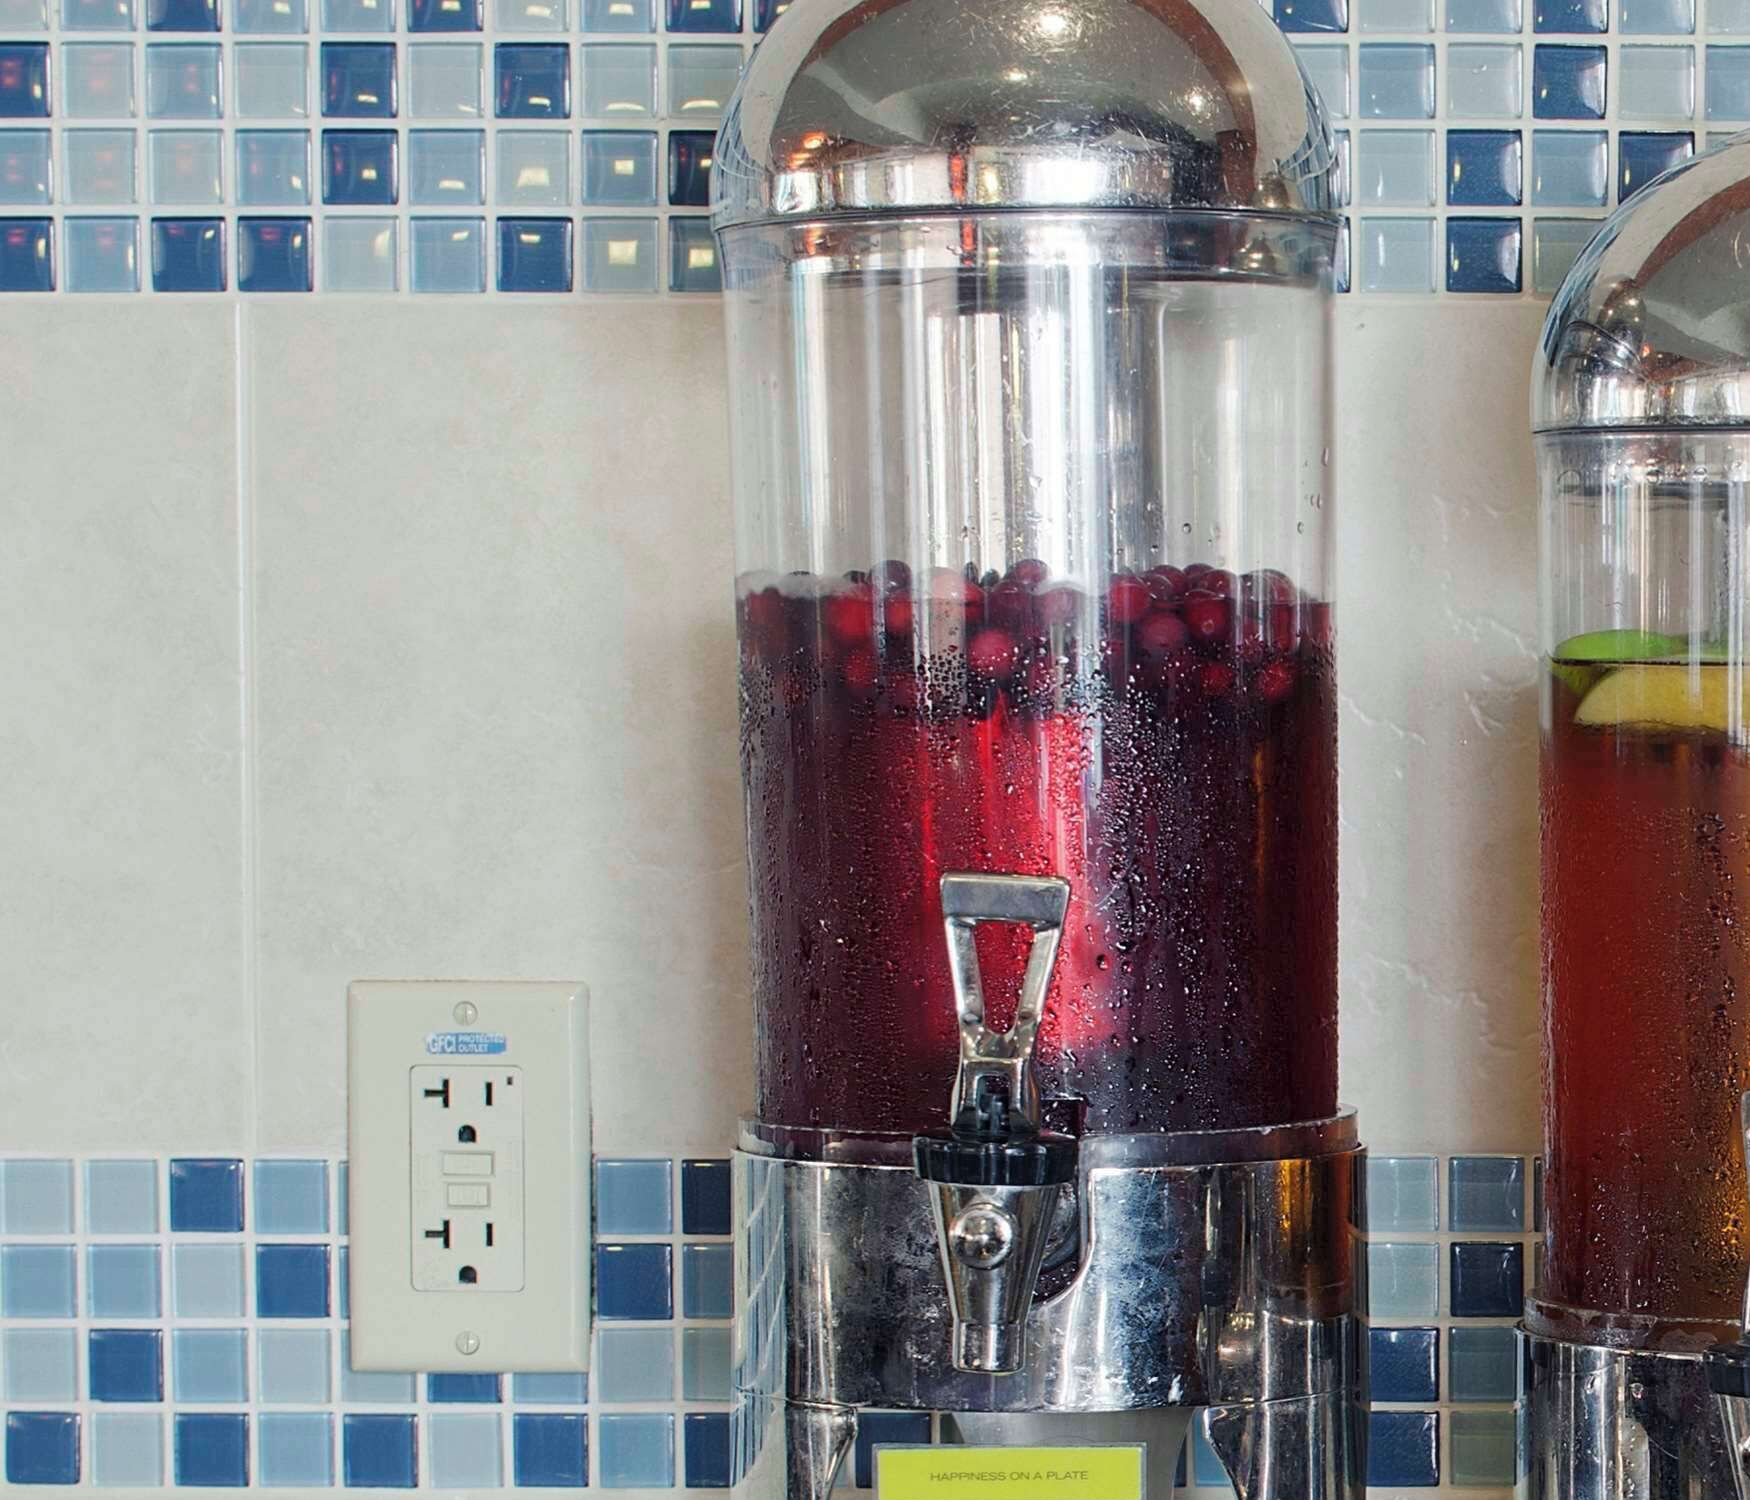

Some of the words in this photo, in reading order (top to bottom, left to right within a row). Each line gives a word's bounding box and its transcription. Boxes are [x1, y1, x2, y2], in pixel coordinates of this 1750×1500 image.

[429, 1034, 456, 1053] GFCI
[458, 1044, 488, 1053] OUTLET
[930, 1471, 1006, 1482] HAPPINESS
[1010, 1471, 1032, 1481] ON
[1032, 1471, 1043, 1481] A
[1046, 1470, 1089, 1481] PLATE
